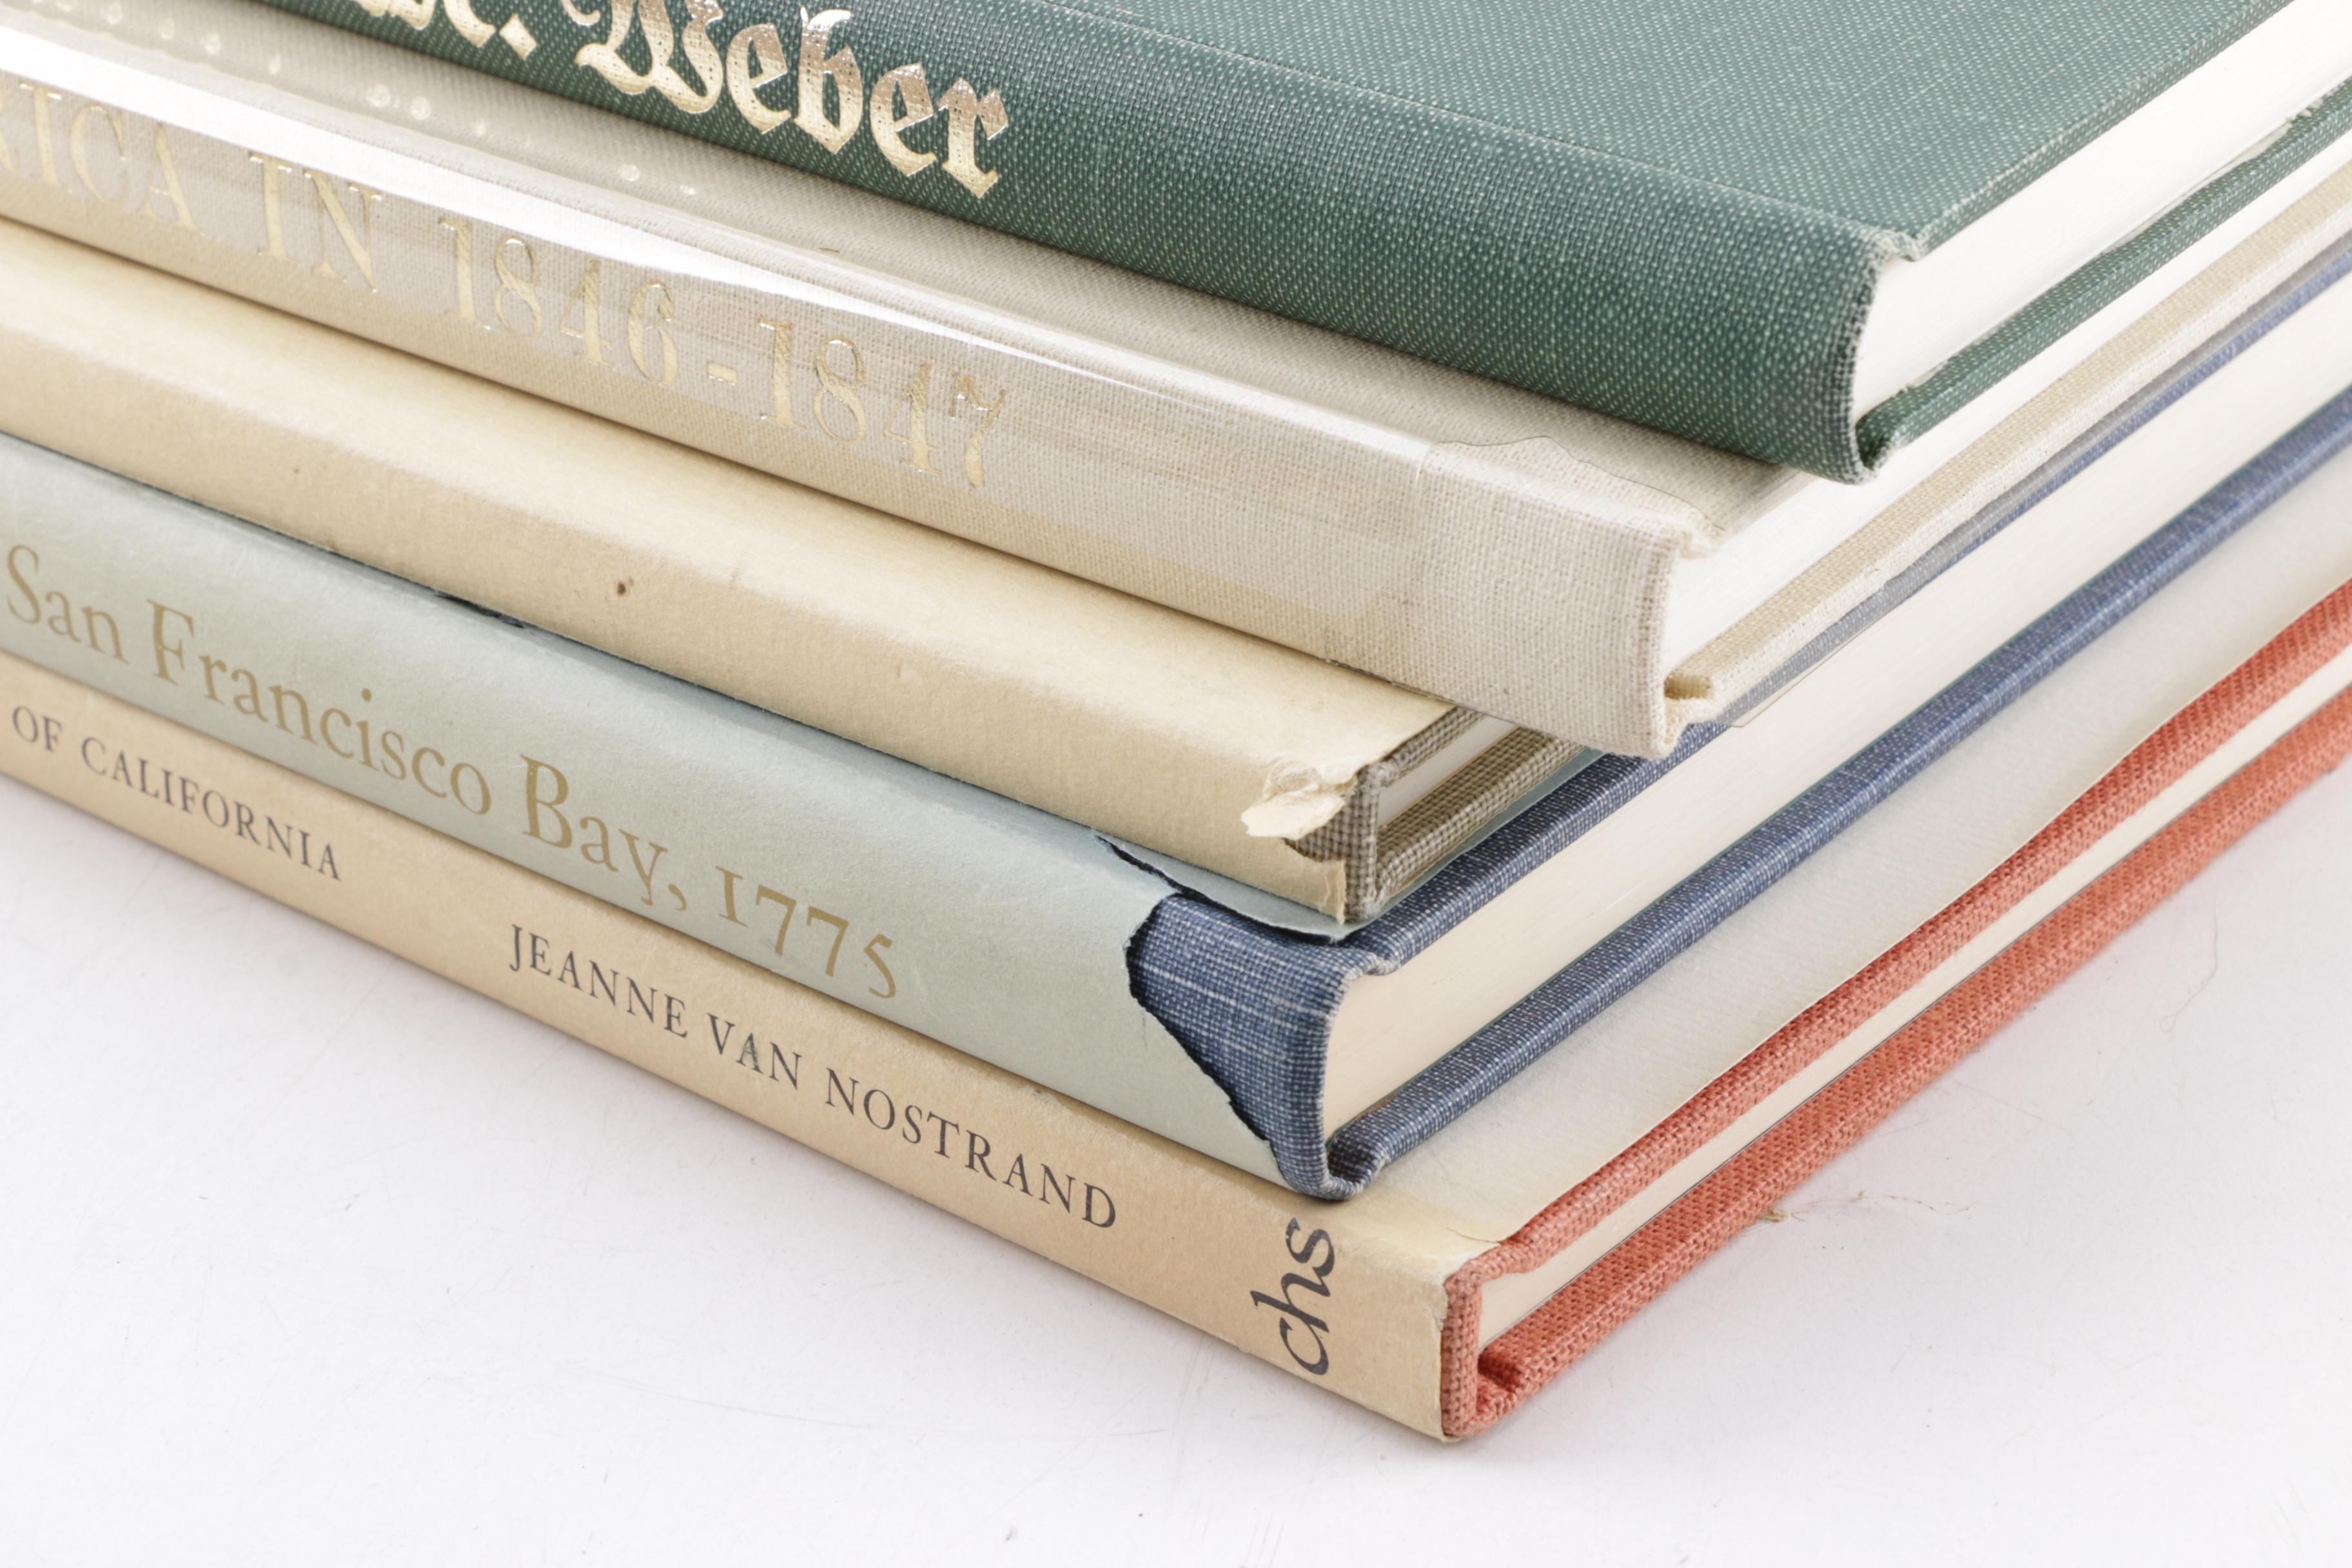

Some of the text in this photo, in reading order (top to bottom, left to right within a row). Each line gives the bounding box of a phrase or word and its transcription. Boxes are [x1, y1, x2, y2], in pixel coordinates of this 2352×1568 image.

[0, 80, 204, 235] ICA
[249, 151, 383, 293] IN
[6, 544, 897, 999] San Francisco Bay, 1775
[12, 705, 342, 881] OF CALIFORNIA
[508, 924, 1117, 1229] JEANNE VAN NOSTRAND
[1250, 1217, 1337, 1376] chs
